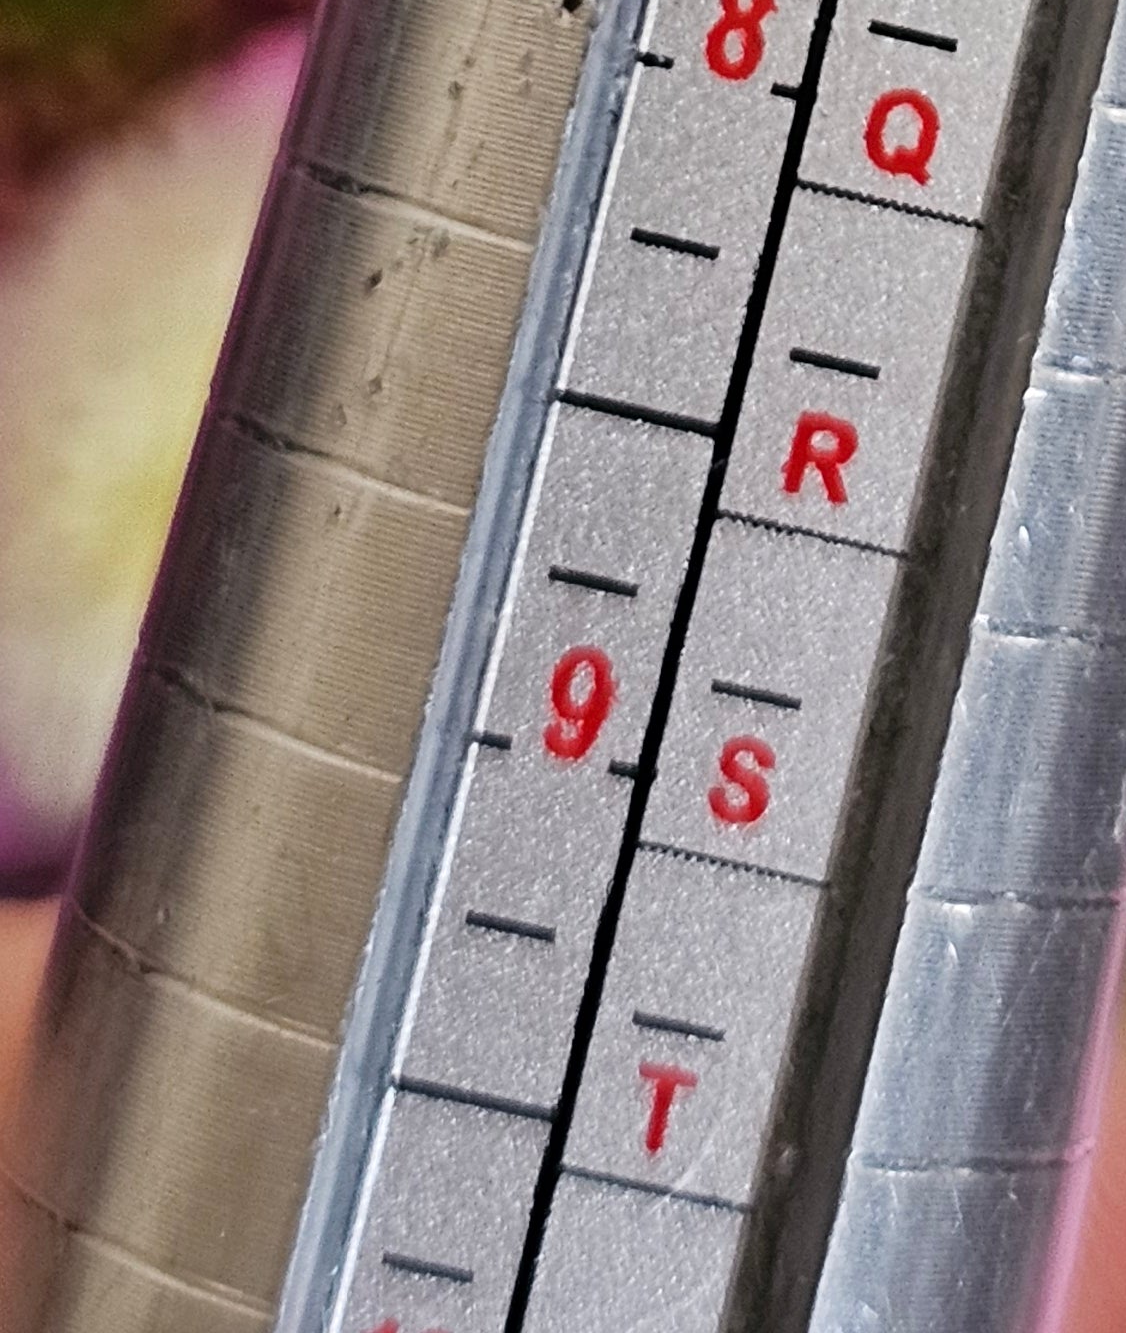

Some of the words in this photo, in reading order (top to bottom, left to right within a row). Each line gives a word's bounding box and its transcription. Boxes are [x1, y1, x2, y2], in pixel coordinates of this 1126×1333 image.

[862, 89, 940, 186] Q
[780, 415, 858, 506] R
[541, 646, 618, 763] 9
[706, 736, 777, 829] S
[639, 1063, 698, 1157] T
